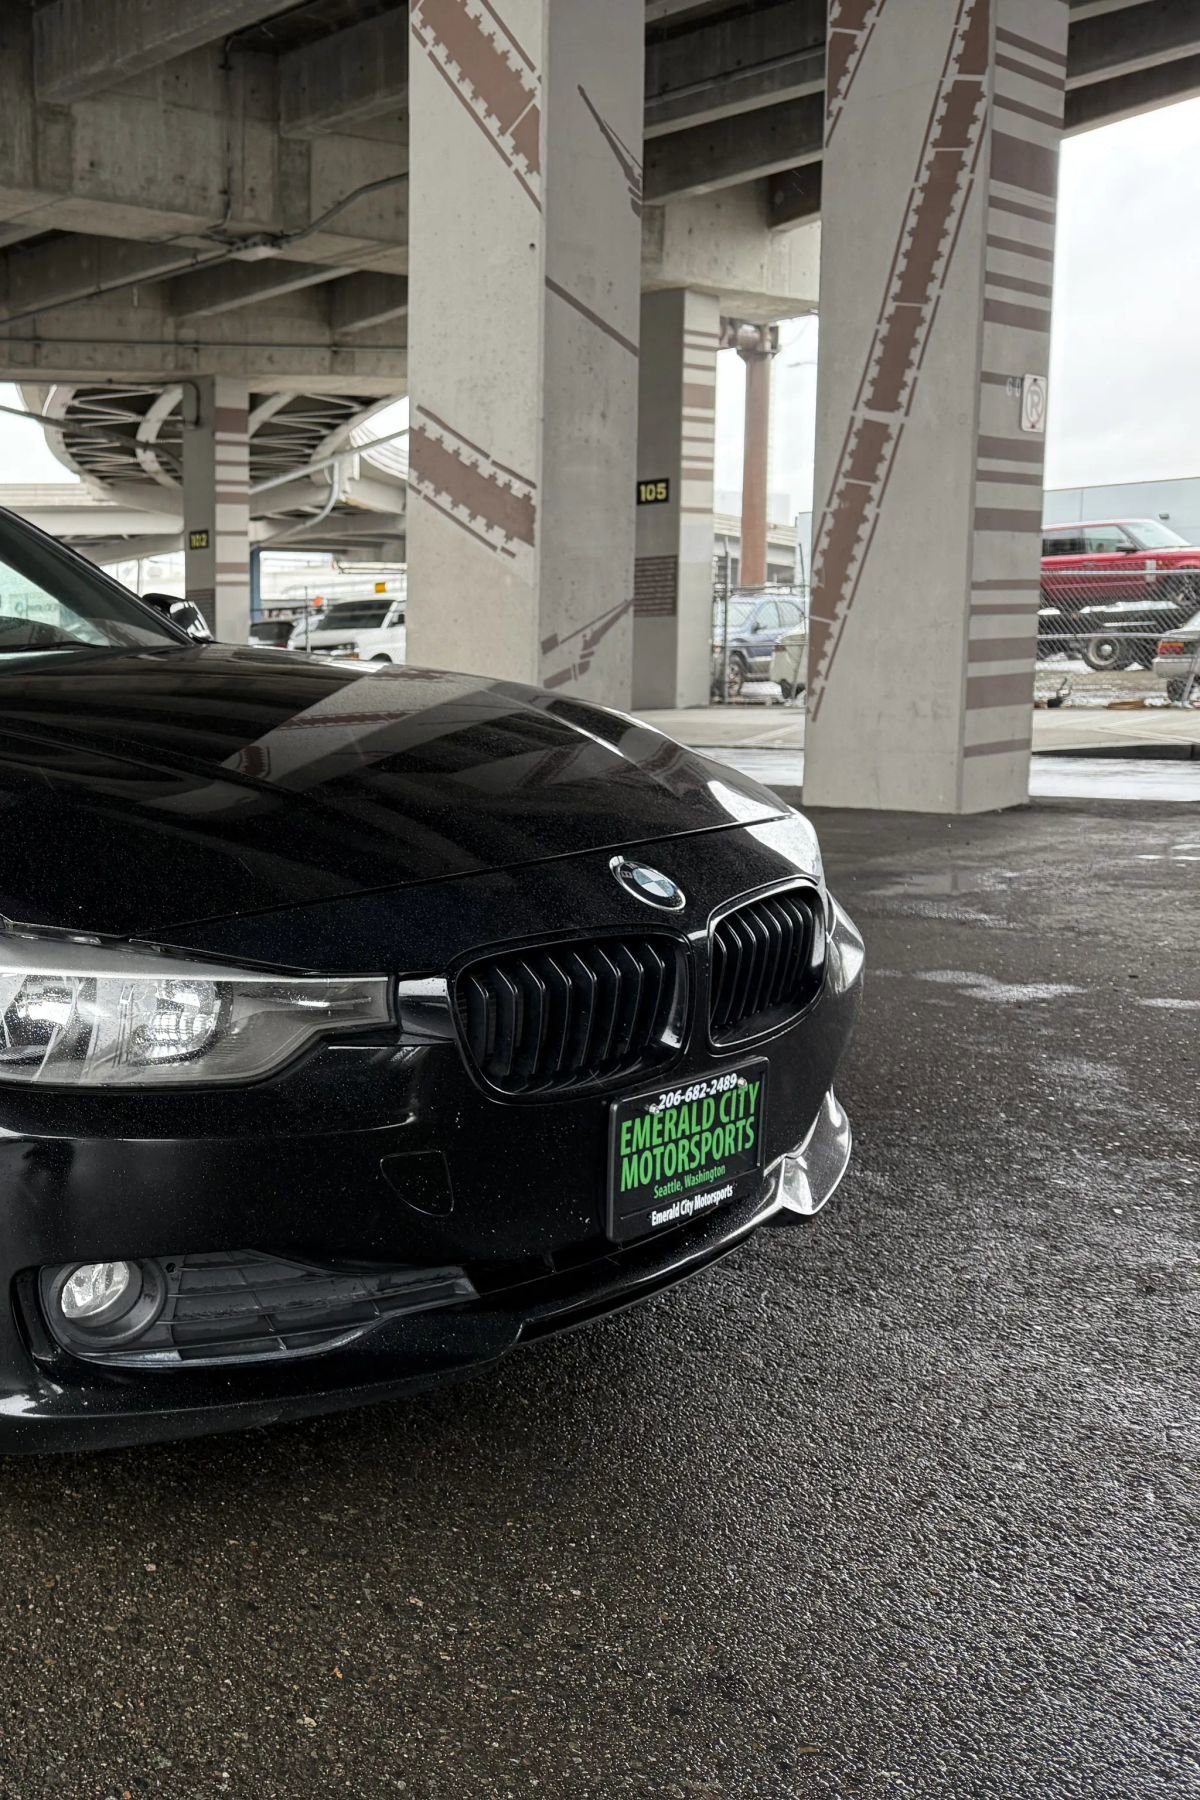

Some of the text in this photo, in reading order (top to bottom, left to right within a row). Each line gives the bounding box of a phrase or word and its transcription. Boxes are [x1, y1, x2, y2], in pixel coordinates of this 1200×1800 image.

[640, 482, 667, 502] 105
[658, 1073, 738, 1110] 206-682-2489
[620, 1081, 760, 1156] EMERALD CITY
[620, 1116, 755, 1192] MOTORSPORTS
[653, 1164, 726, 1199] Seattle, Washington
[651, 1184, 733, 1226] Emerald City Motorsports
